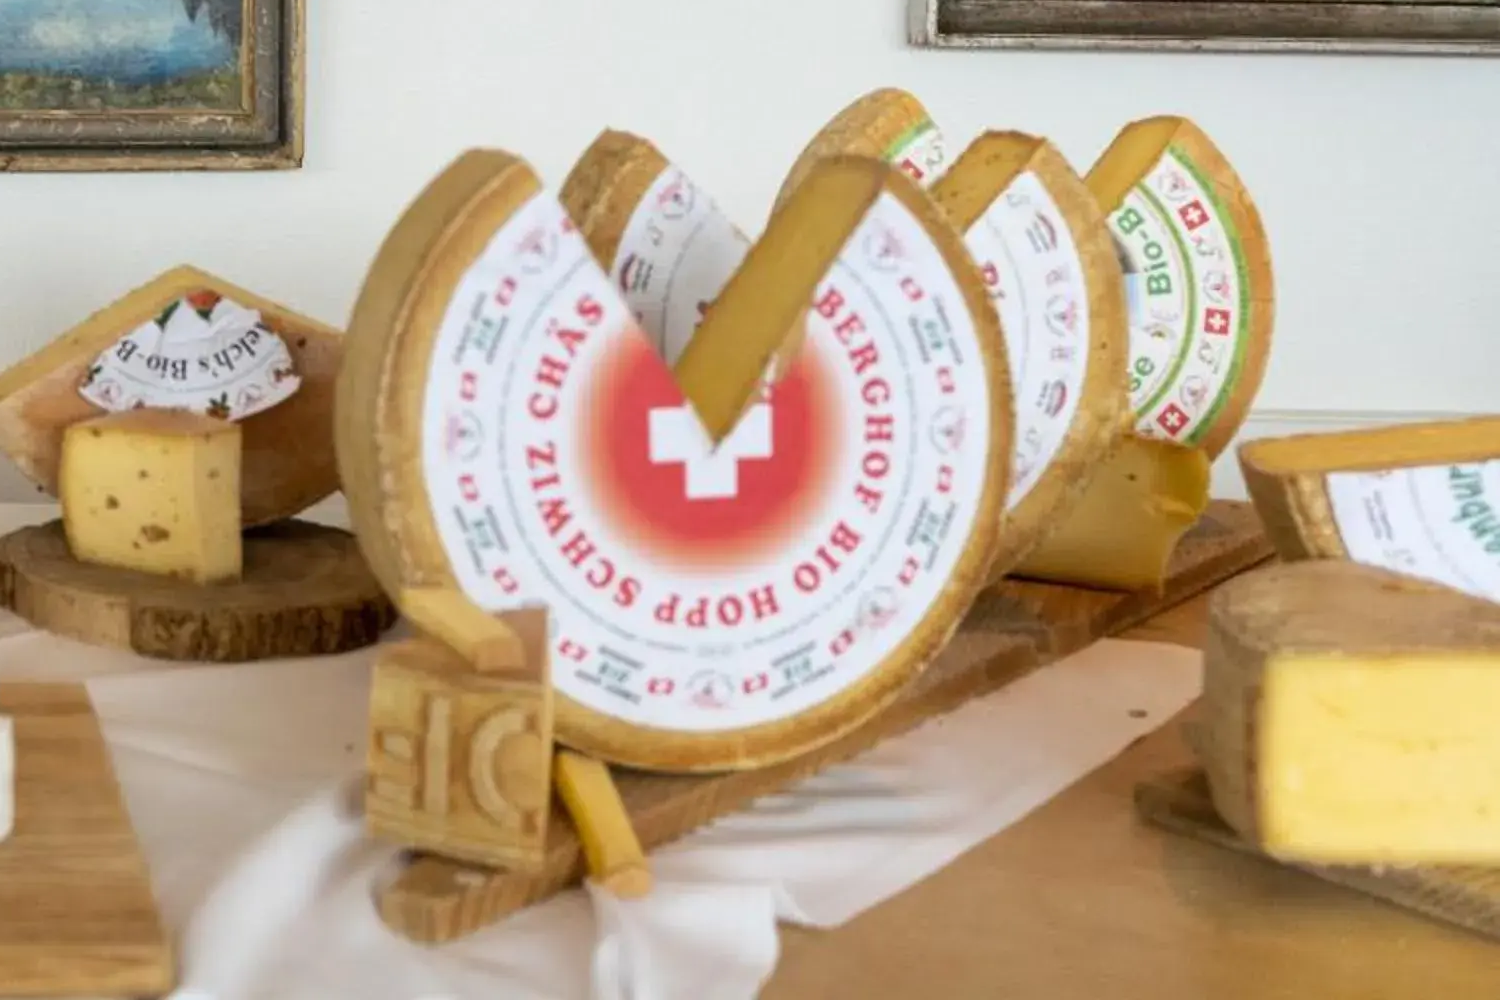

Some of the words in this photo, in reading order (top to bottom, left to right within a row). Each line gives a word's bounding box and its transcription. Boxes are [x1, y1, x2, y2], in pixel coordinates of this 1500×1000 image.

[527, 293, 605, 421] CHÄS
[812, 285, 894, 513] BERGHOF
[526, 440, 642, 608] SCHWIZ
[792, 521, 862, 593] BIO
[653, 584, 781, 628] HOPP
